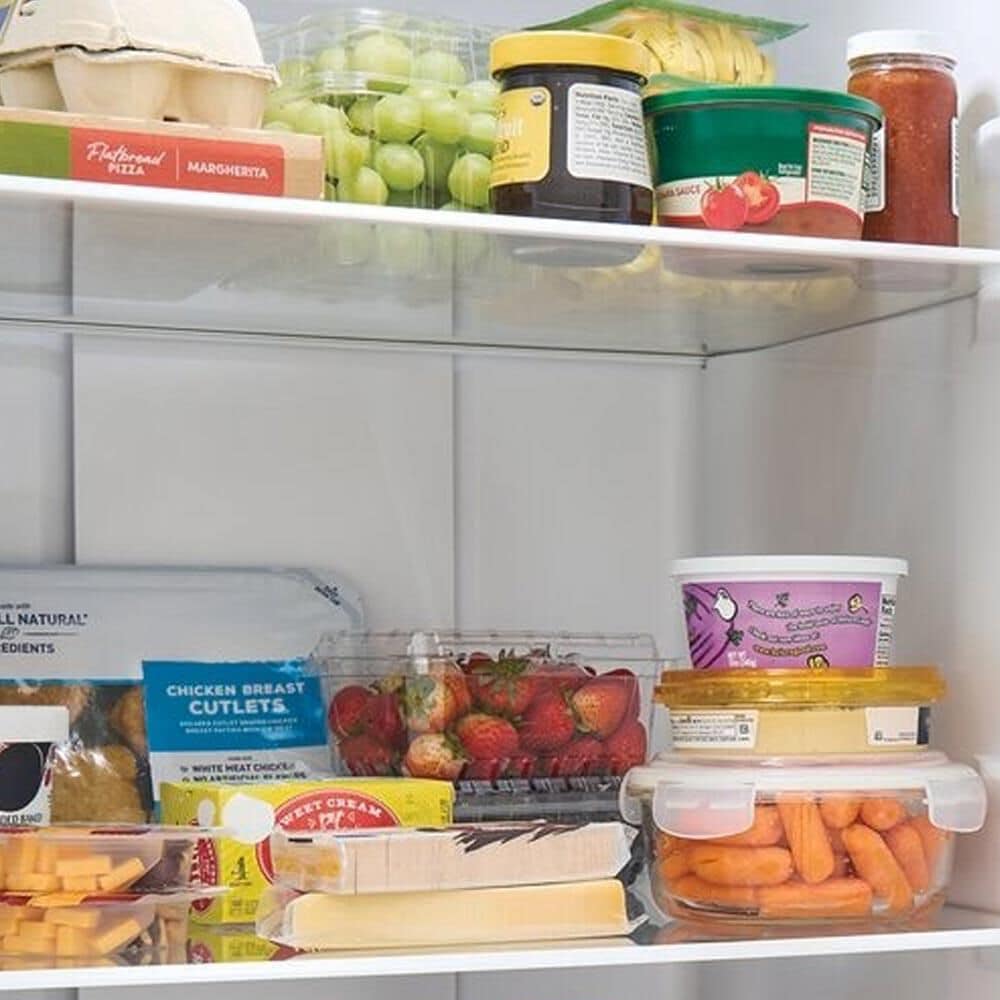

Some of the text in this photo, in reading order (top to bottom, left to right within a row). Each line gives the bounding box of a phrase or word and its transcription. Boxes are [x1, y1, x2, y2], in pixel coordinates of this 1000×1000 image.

[87, 141, 167, 165] Flatbread
[108, 162, 145, 177] PIZZA
[187, 160, 270, 181] MARGHERITA
[0, 642, 55, 653] EDIENTS
[166, 682, 305, 697] CHICKEN BREAST
[189, 698, 287, 715] CUTLETS
[225, 763, 252, 773] MEAT
[278, 800, 322, 826] WEET
[327, 798, 382, 818] CREAM
